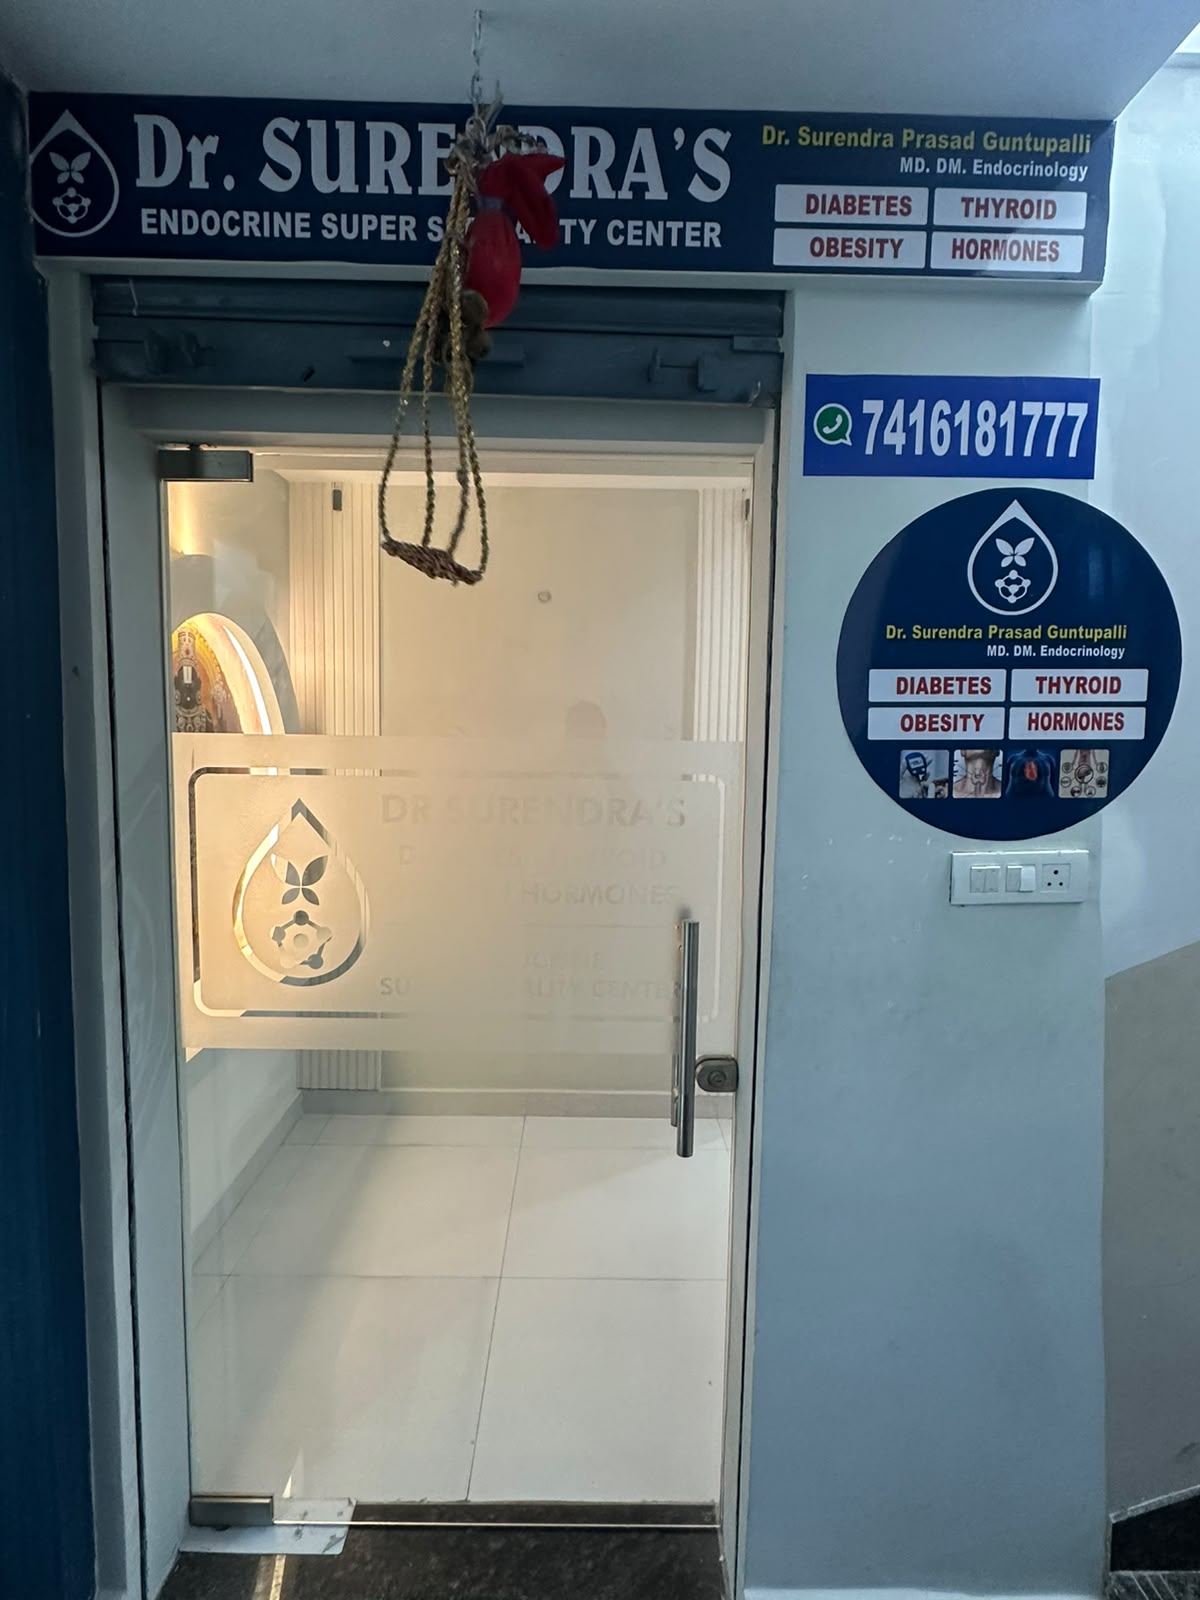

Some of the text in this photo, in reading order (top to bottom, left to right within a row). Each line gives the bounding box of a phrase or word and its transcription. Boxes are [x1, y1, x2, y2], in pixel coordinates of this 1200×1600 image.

[762, 125, 1092, 156] Dr. Surendra Prasad Guntupalli
[133, 113, 732, 203] Dr. SUREDRA'S
[900, 157, 1088, 182] MD. DM. Endocrinology
[805, 193, 912, 217] DIABETES
[961, 197, 1057, 220] THYROID
[141, 208, 311, 240] ENDOCRINE
[321, 213, 417, 243] SUPER
[606, 219, 722, 248] CENTER
[809, 237, 904, 259] OBESITY
[951, 238, 1060, 262] HORMONES
[862, 399, 1089, 458] 7416181777
[886, 624, 1128, 642] Dr. Surendra Prasad Guntupalli
[987, 645, 1126, 660] MD. DM. Endocrinology
[896, 676, 992, 695] DIABETES
[1035, 676, 1122, 695] THYROID
[900, 714, 985, 732] OBESITY
[1027, 712, 1125, 731] HORMONES
